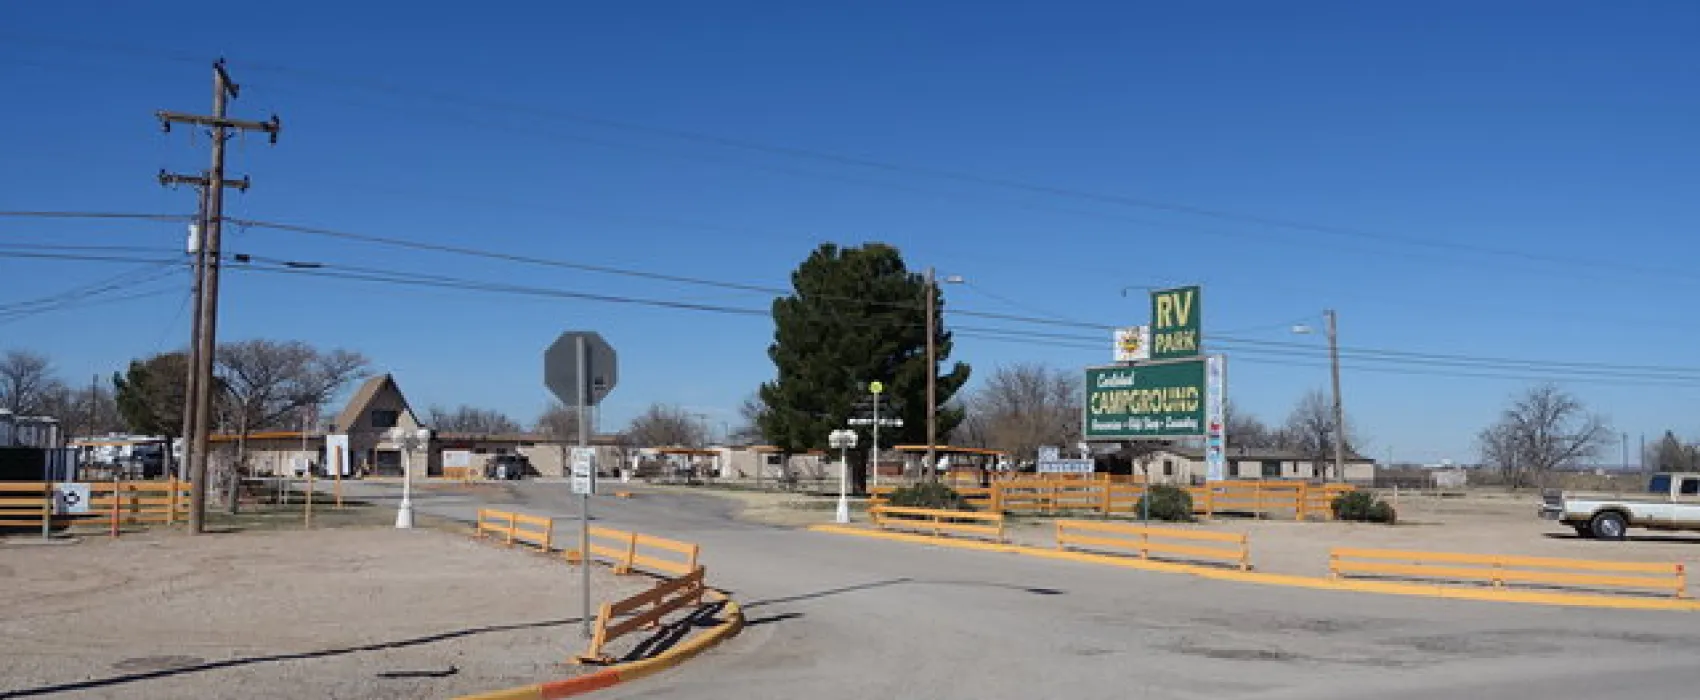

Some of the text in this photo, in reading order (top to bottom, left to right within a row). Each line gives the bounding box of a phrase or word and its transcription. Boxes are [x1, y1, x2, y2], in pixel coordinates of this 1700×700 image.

[1157, 291, 1193, 329] RV
[1155, 330, 1196, 353] PARK
[1091, 386, 1199, 415] CAMPGROUND
